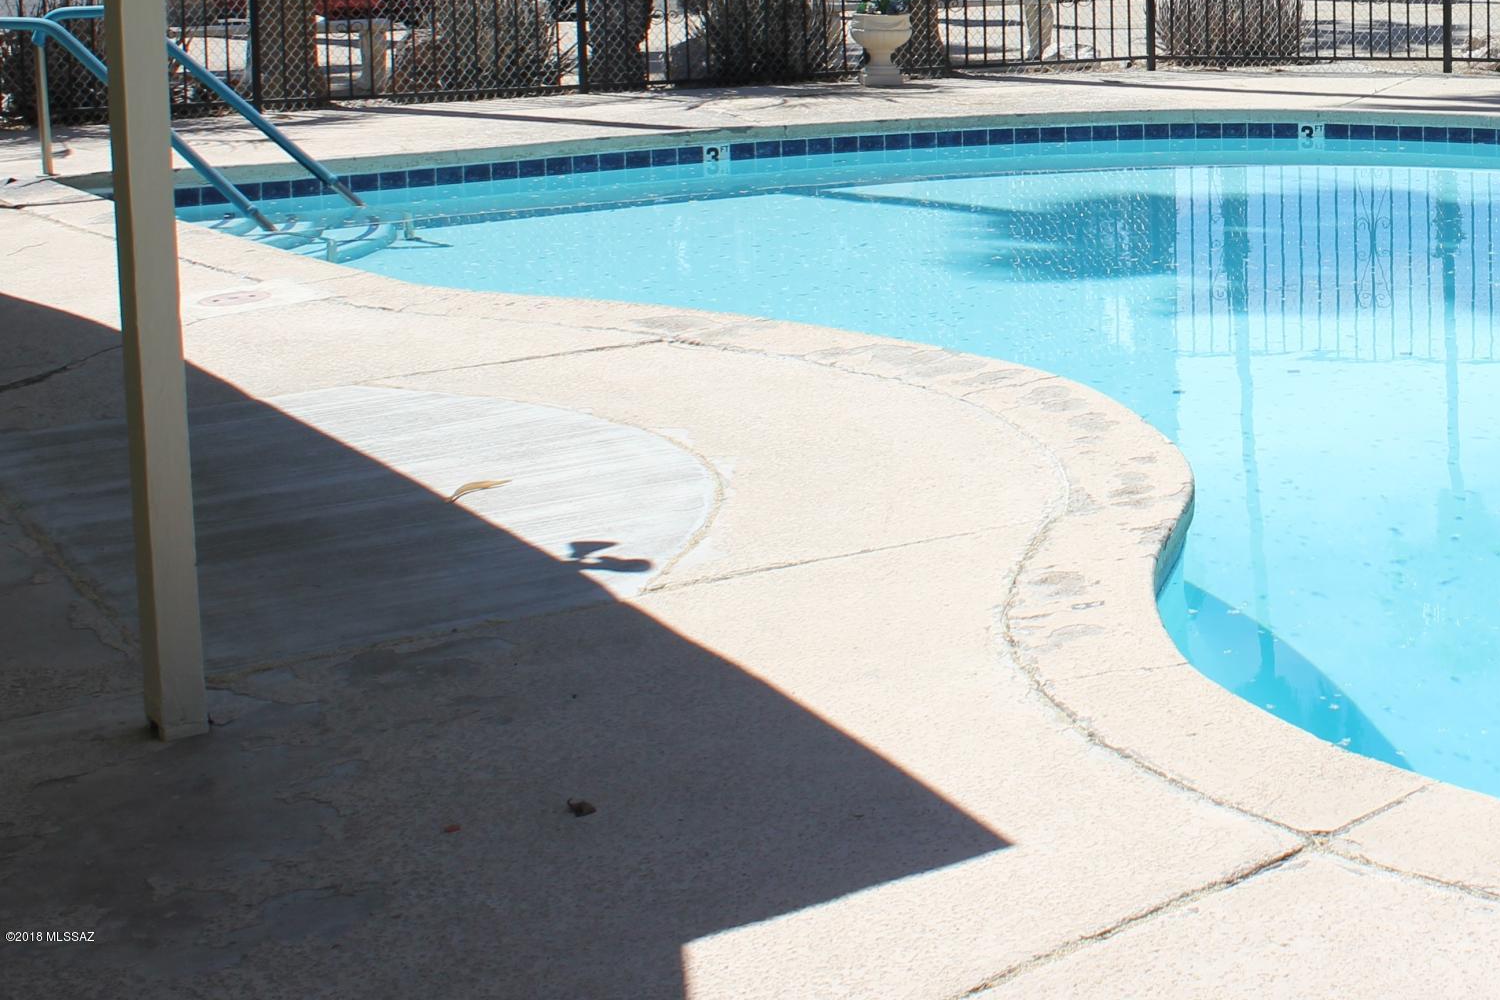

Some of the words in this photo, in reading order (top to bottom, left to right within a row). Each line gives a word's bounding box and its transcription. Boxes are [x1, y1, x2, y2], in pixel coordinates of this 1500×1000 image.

[1301, 125, 1314, 138] 3
[706, 147, 719, 161] 3
[720, 145, 729, 153] FT
